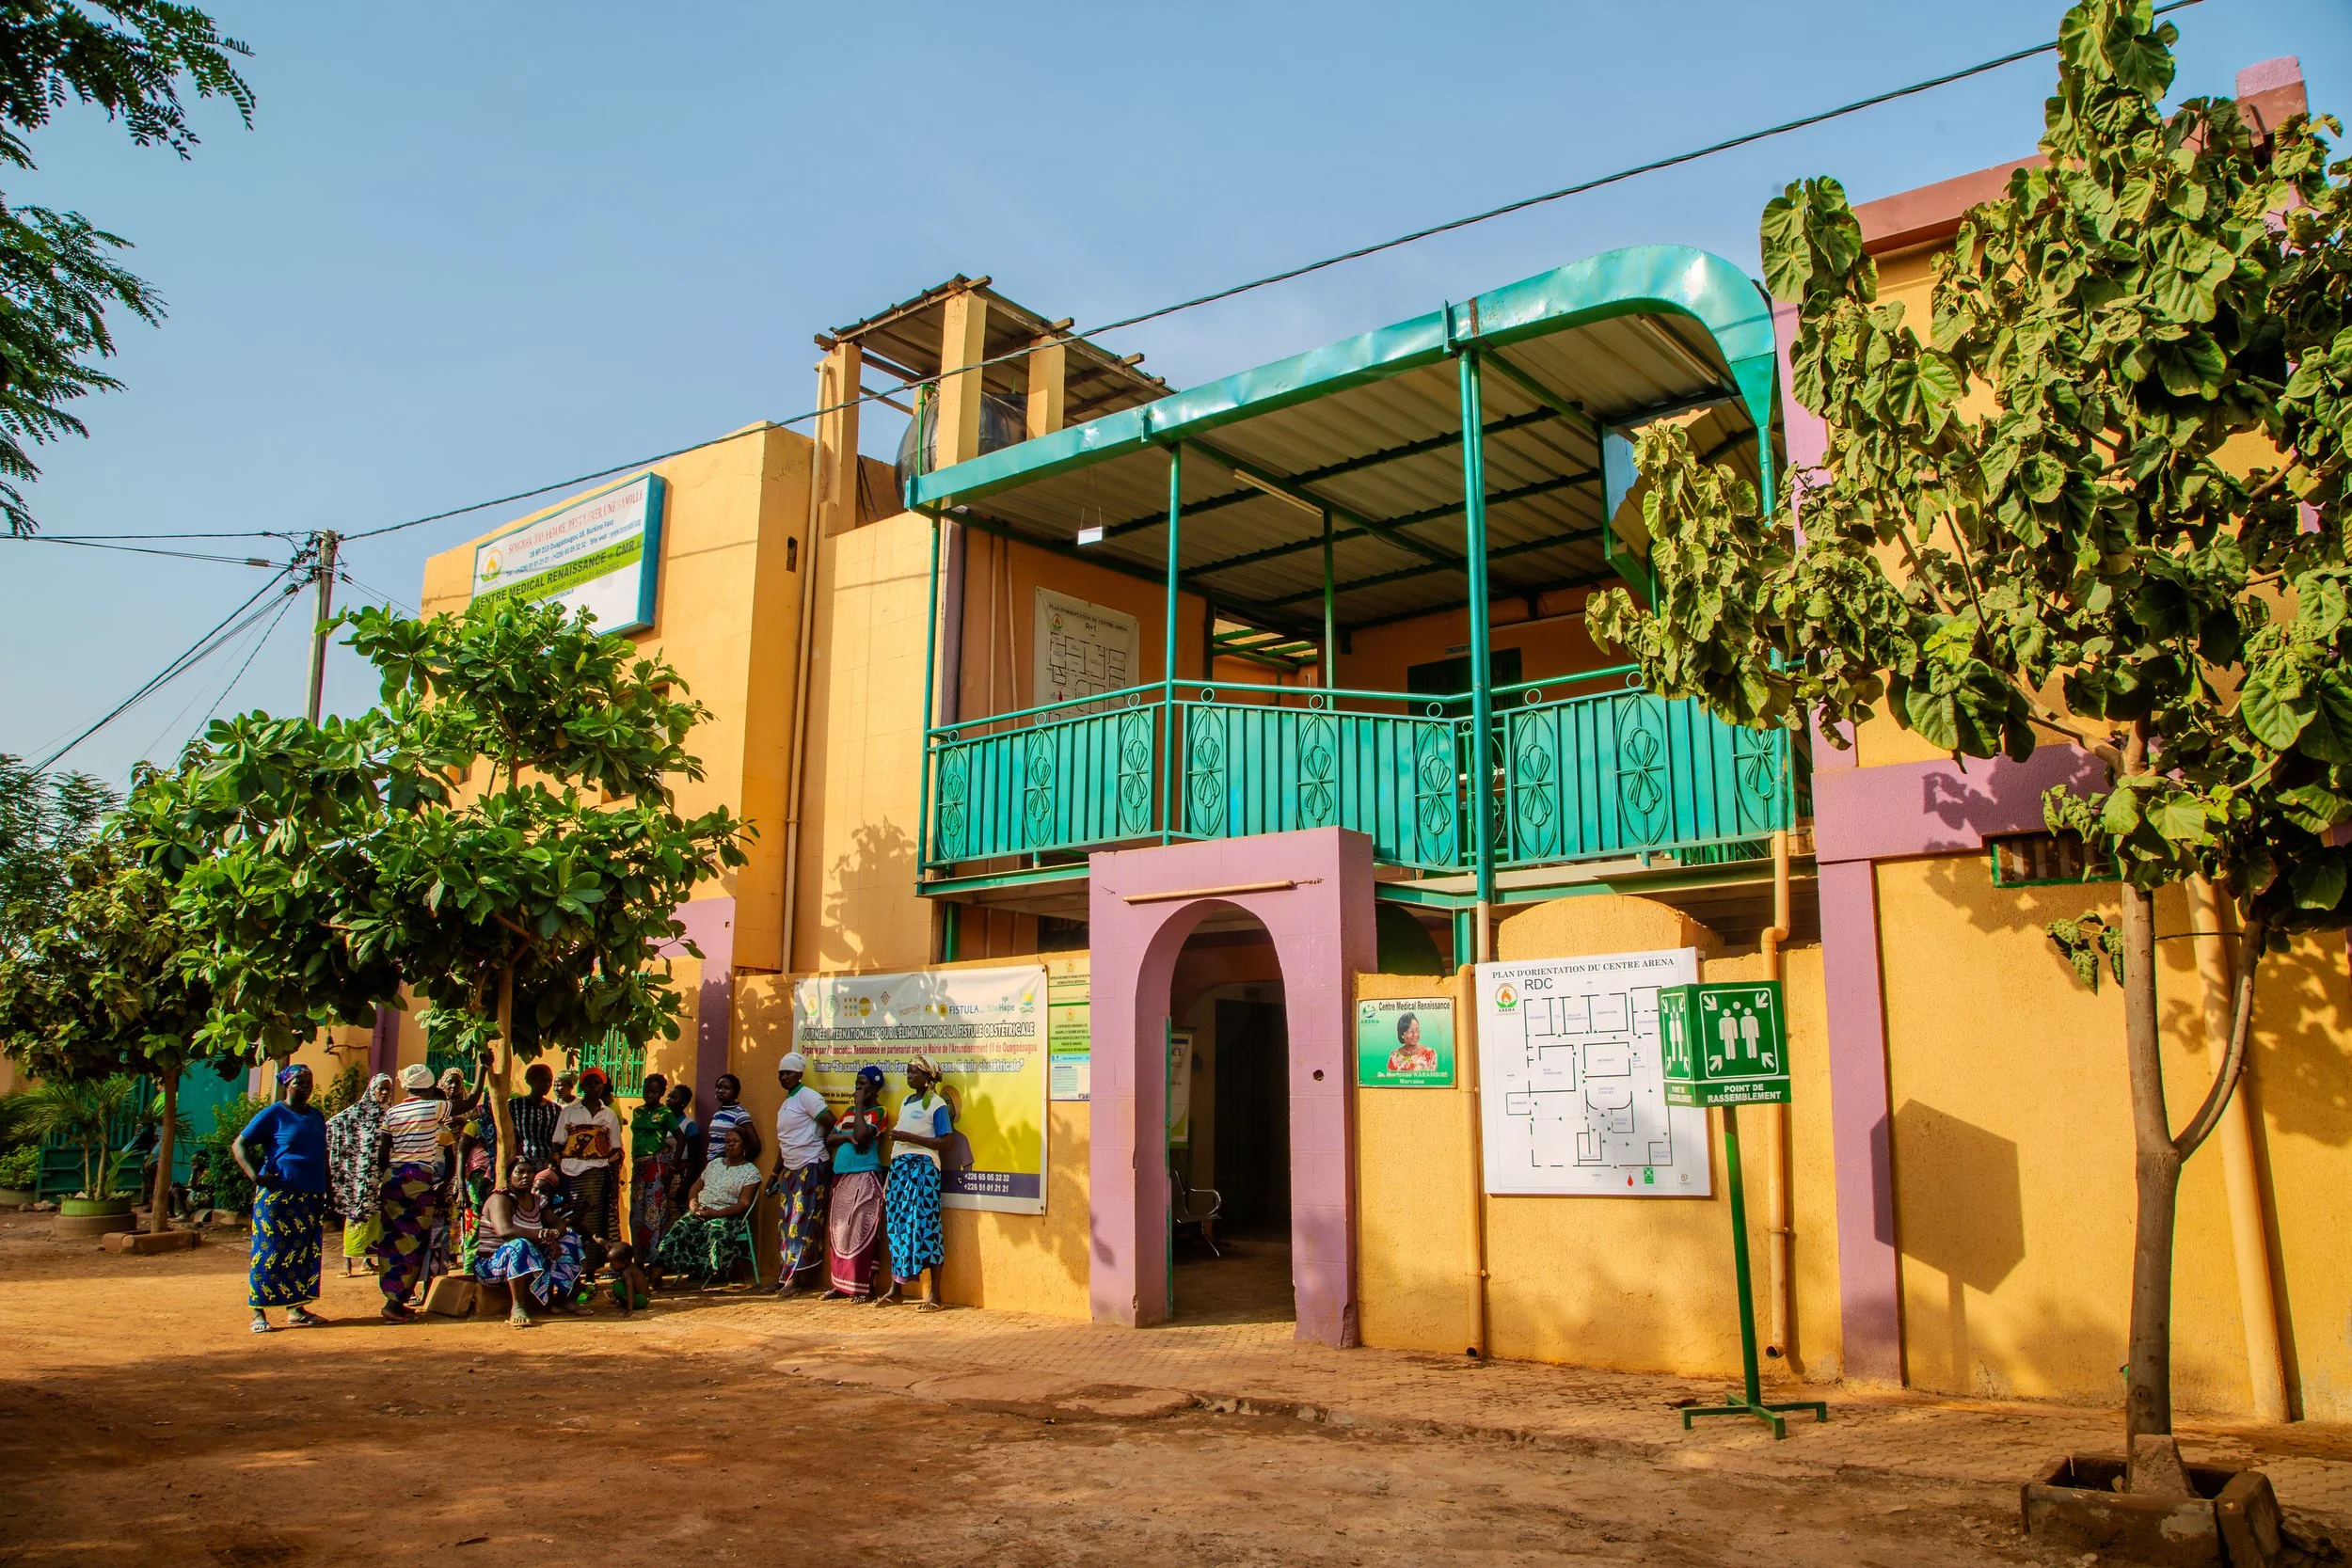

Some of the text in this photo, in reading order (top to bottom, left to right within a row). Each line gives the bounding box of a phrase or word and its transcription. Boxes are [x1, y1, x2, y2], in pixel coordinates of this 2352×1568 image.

[617, 490, 644, 510] FAMILLE
[477, 592, 506, 610] ENTRE
[510, 576, 546, 597] MEDICAL
[548, 552, 606, 585] RENAISSANCE
[615, 540, 635, 555] CMR
[1086, 622, 1097, 632] R+1
[1517, 965, 1585, 977] D'ORIENTATION
[1588, 963, 1601, 972] DU
[1603, 960, 1640, 971] CENTRE
[1642, 958, 1675, 968] ARENA
[1524, 978, 1553, 990] RDC
[948, 1005, 978, 1014] FISTULA
[1379, 1001, 1451, 1010] Centre Medical Renaissance
[828, 1027, 875, 1040] INTERNATIONALE
[876, 1027, 894, 1040] POUR
[938, 1025, 946, 1038] DE
[946, 1024, 958, 1038] LA
[958, 1023, 984, 1038] FISTULE
[984, 1020, 1035, 1038] OBSTÉTRICALE
[854, 1044, 881, 1053] Renaissance
[886, 1044, 911, 1055] partenariat
[922, 1045, 928, 1053] la
[928, 1044, 941, 1053] Mairie
[943, 1044, 948, 1053] de
[995, 1042, 1002, 1052] de
[1003, 1042, 1038, 1054] Ouagadougou
[1724, 1085, 1751, 1093] POINT
[1707, 1091, 1782, 1102] RASSEMBLEMENT
[965, 1172, 977, 1180] +226
[986, 1173, 993, 1181] 05
